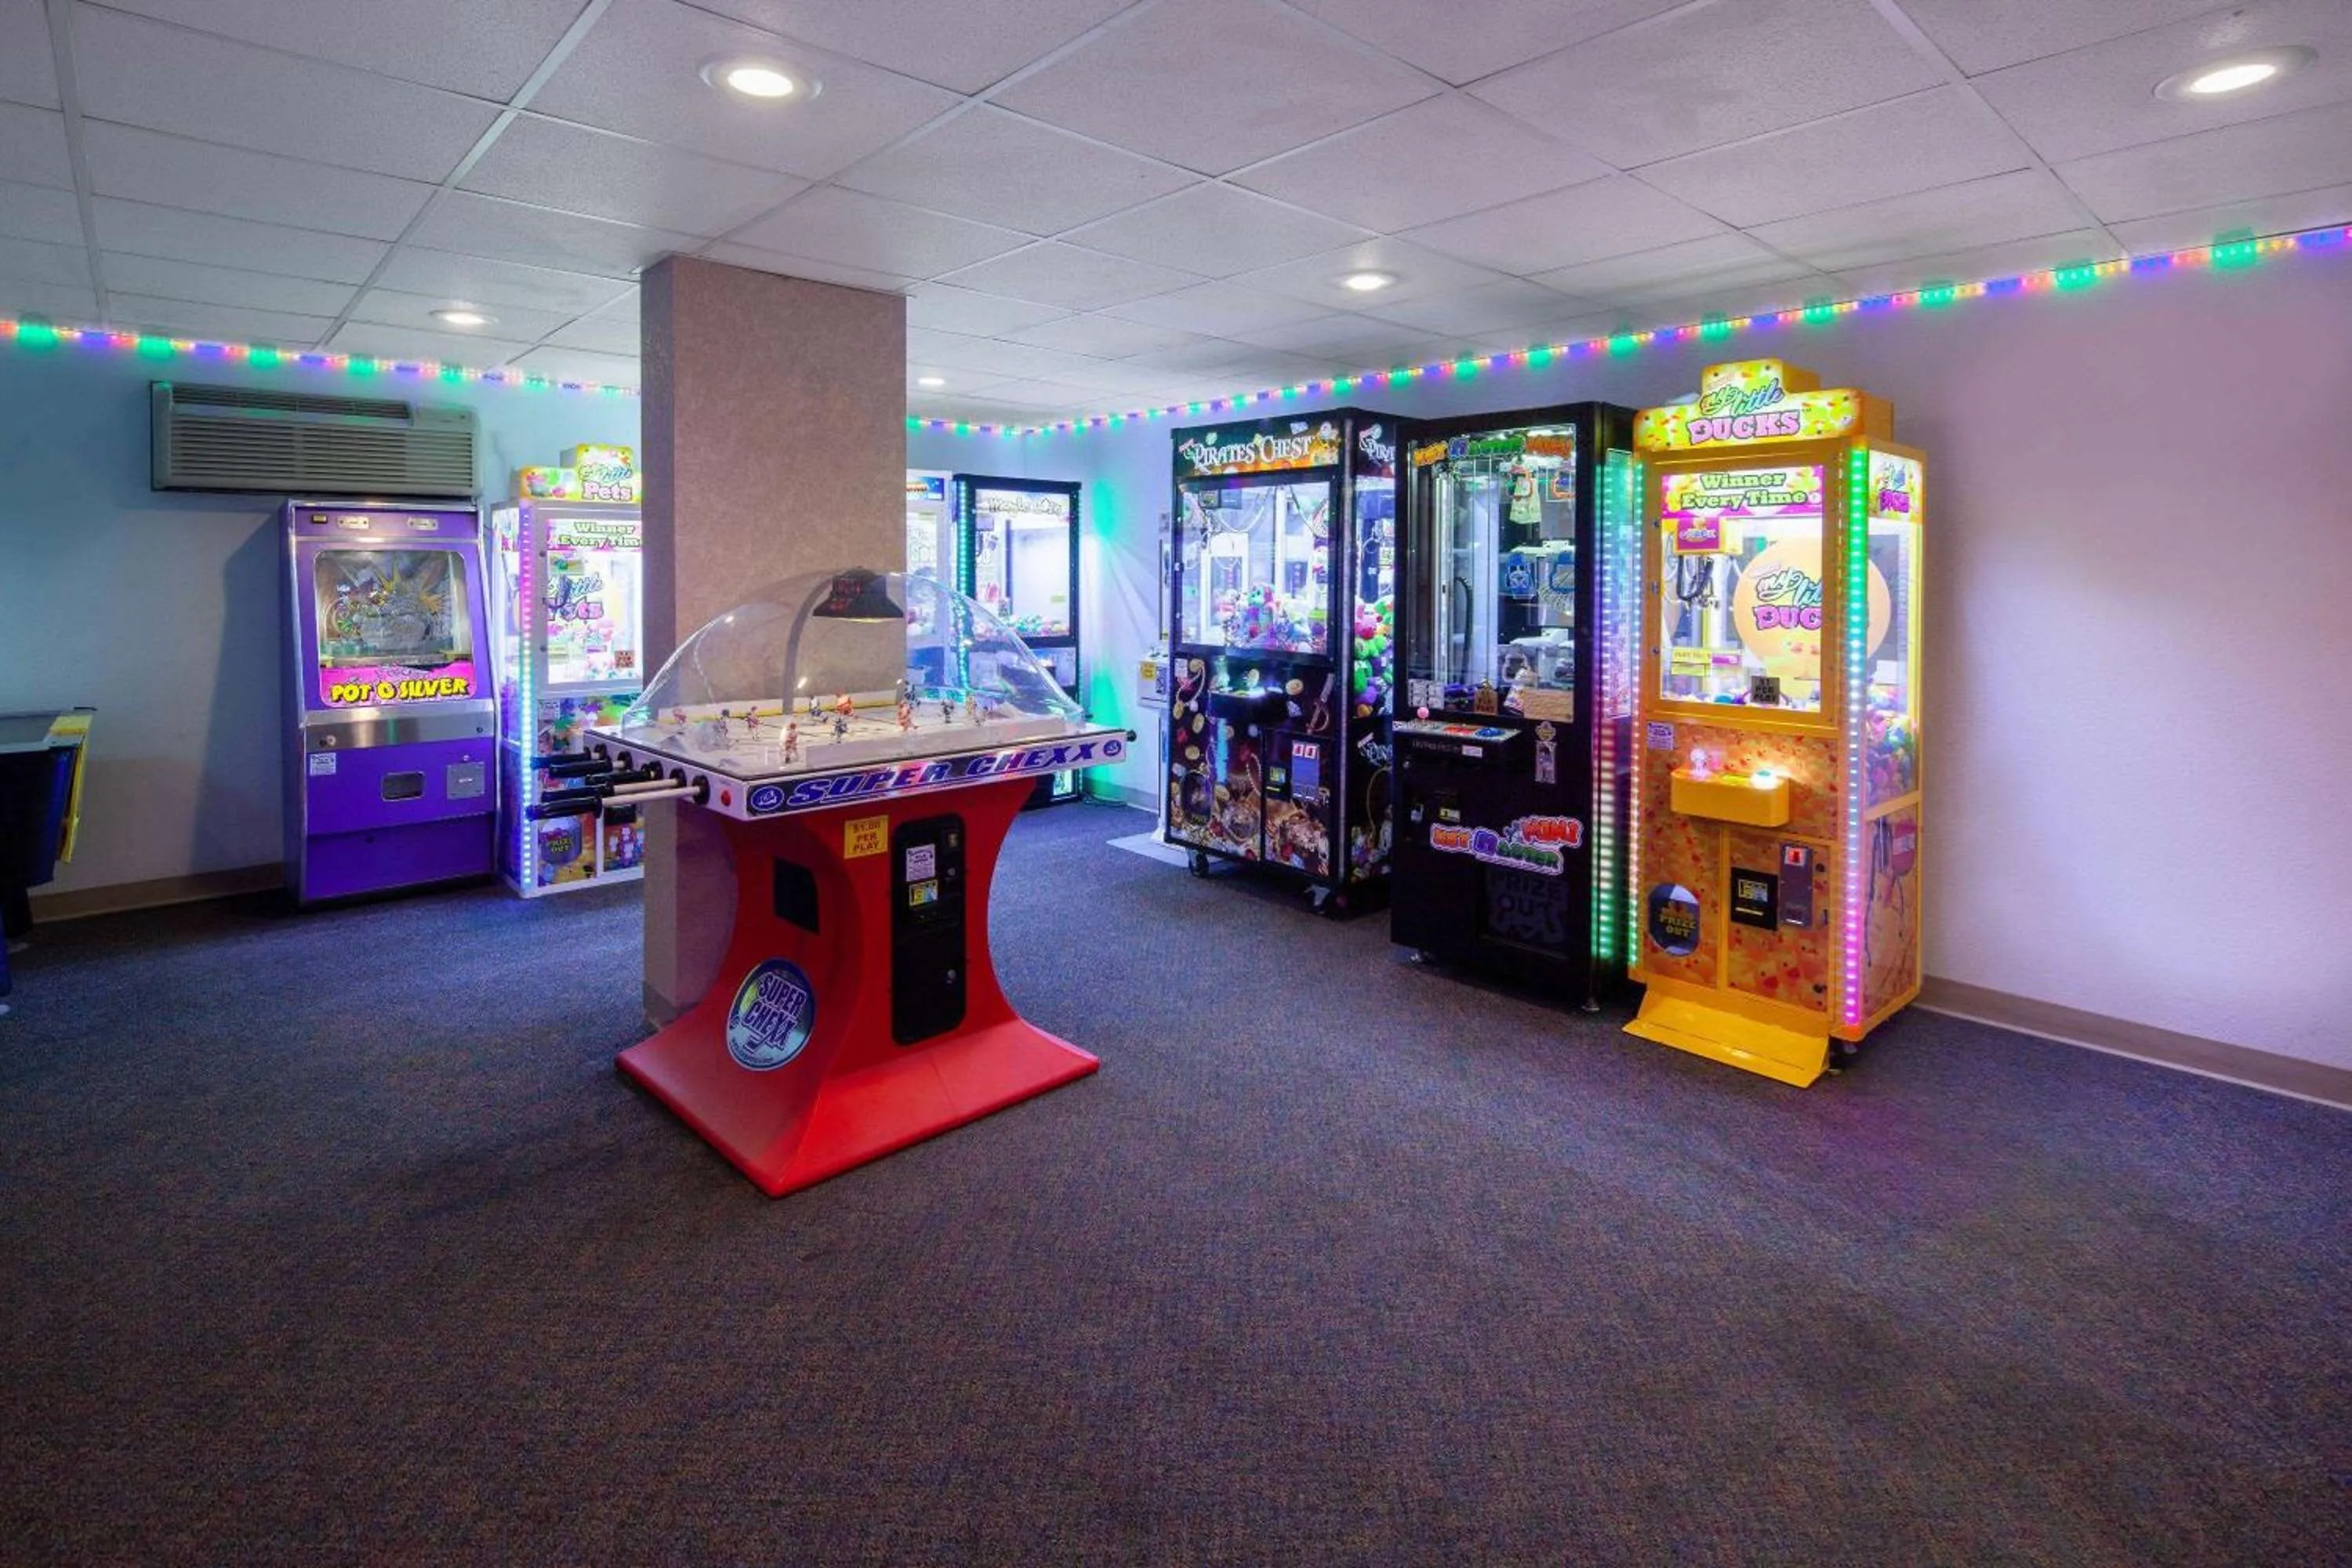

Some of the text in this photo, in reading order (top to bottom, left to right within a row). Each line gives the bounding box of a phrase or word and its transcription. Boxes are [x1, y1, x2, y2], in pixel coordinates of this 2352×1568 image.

[1686, 408, 1801, 445] DUCKS
[1258, 433, 1316, 464] CHEST
[582, 481, 633, 501] Pets
[1699, 473, 1787, 490] Winner
[1680, 488, 1808, 512] Every Time
[573, 521, 637, 534] Winner
[331, 683, 372, 703] POT
[398, 677, 470, 699] SILVER
[786, 760, 953, 806] SUPER
[965, 741, 1099, 776] CHEXX
[853, 841, 880, 851] PLAY
[856, 832, 878, 841] PER
[1659, 913, 1697, 930] PRIZE
[1665, 925, 1691, 938] OUT
[757, 972, 808, 1018] SUPER
[742, 1000, 798, 1051] CHEXX
